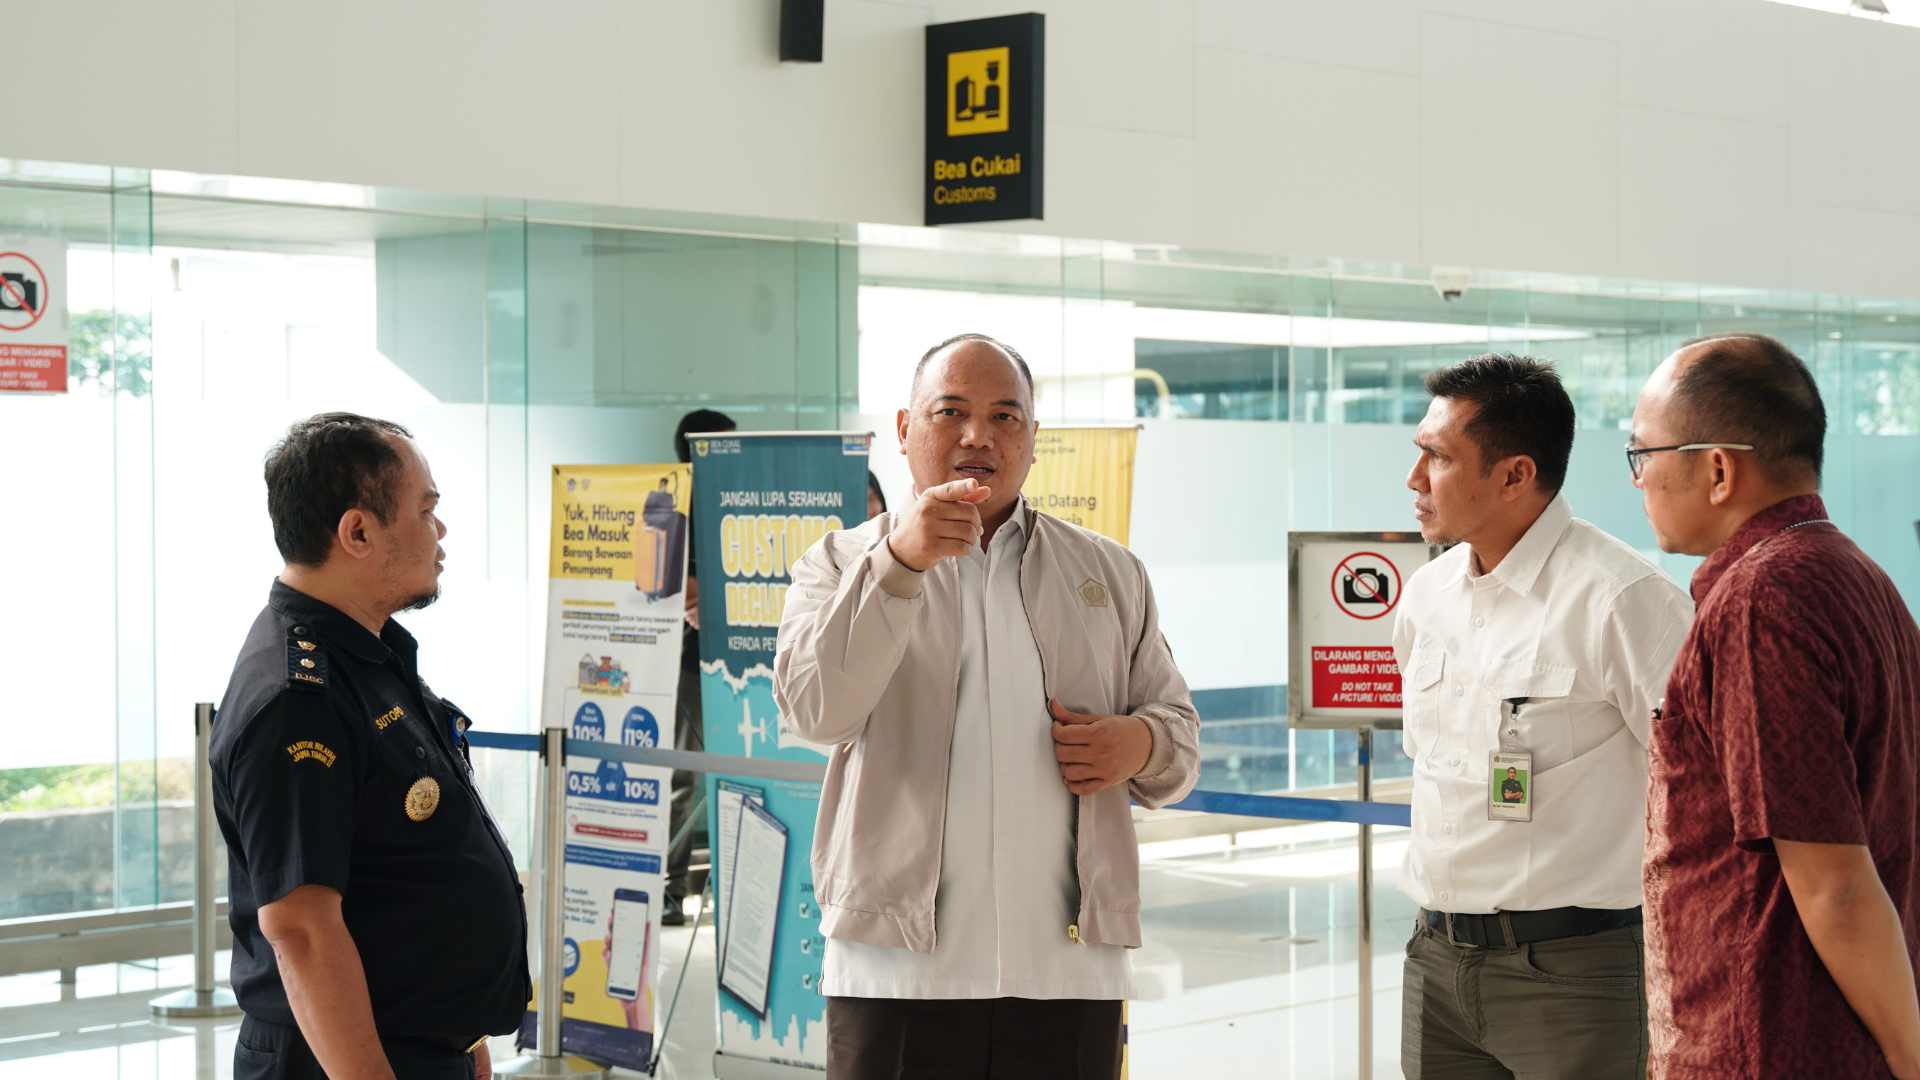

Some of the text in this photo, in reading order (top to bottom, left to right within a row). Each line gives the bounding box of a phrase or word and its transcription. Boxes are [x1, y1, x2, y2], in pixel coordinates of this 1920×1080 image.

[934, 153, 1021, 180] Bea Cukai
[934, 186, 997, 205] Customs
[719, 491, 843, 508] JANGAN LUPA SERAHKAN
[1048, 494, 1097, 511] Datang
[563, 503, 636, 526] Yuk, Hitung
[563, 525, 630, 542] Bea Masuk
[563, 546, 633, 561] Barang Bawaan
[563, 561, 613, 578] Penumpang
[728, 635, 761, 651] KEPADA
[1314, 650, 1362, 661] DILARANG
[1328, 663, 1370, 674] GAMBAR
[1341, 682, 1394, 691] DO NOT TAKE
[1332, 693, 1339, 702] A
[1340, 693, 1373, 702] PICTURE
[574, 725, 602, 742] 10%
[624, 728, 654, 747] 11%
[569, 774, 602, 794] 0,5%
[623, 781, 656, 800] 10%
